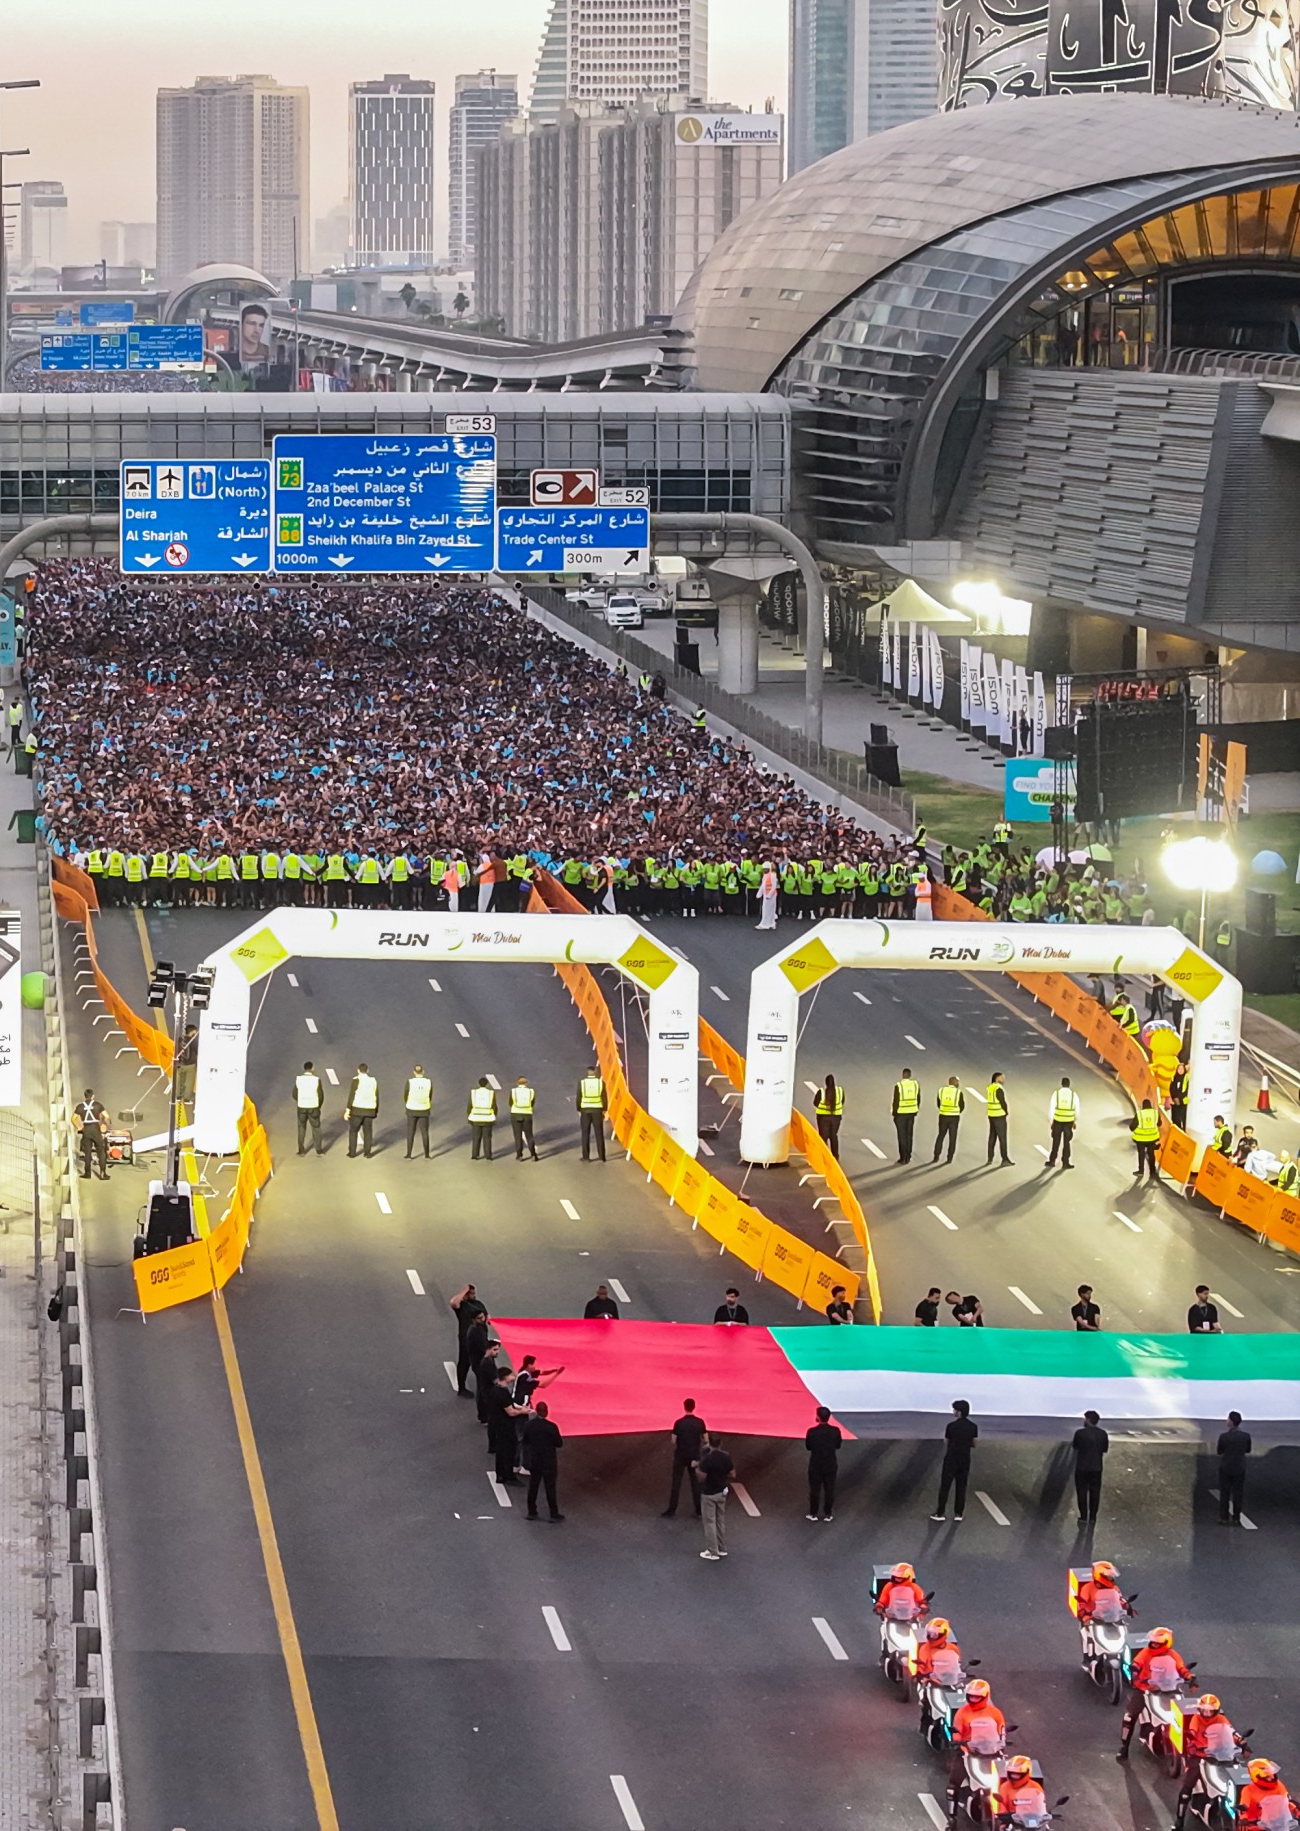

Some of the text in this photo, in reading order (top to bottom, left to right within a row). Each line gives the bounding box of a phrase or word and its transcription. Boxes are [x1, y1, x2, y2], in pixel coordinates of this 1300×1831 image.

[714, 117, 732, 130] the
[703, 127, 778, 143] Apartments
[472, 418, 492, 430] 53
[366, 440, 410, 456] زعبيل
[415, 440, 448, 456] قصر
[218, 466, 268, 482] (شمال)
[333, 465, 382, 477] ديسمبر
[386, 467, 406, 477] من
[413, 462, 449, 478] الثاني
[282, 473, 300, 486] 73
[195, 481, 207, 494] 11
[218, 487, 268, 500] (North)
[306, 482, 424, 493] Zaa'beel Palace St
[306, 496, 411, 507] 2nd December St
[625, 490, 645, 503] 52
[126, 508, 157, 519] Deira
[239, 507, 268, 519] ديرة
[307, 513, 492, 529] شارع الشيخ خليفة بن زايد
[503, 512, 644, 529] شارع المركز التجاري
[126, 530, 188, 542] Al Sharjah
[217, 526, 268, 541] الشارقة
[280, 529, 300, 542] 88
[503, 534, 594, 545] Trade Center St
[307, 534, 471, 548] Sheikh Khalifa Bin Zayed St
[276, 554, 318, 564] 1000m
[567, 553, 603, 564] 300m
[970, 668, 983, 706] wasl
[987, 676, 999, 715] wasl
[378, 932, 429, 947] RUN
[472, 931, 522, 945] Mai Dubai
[929, 946, 980, 961] RUN
[1022, 945, 1071, 960] Mai Dubai
